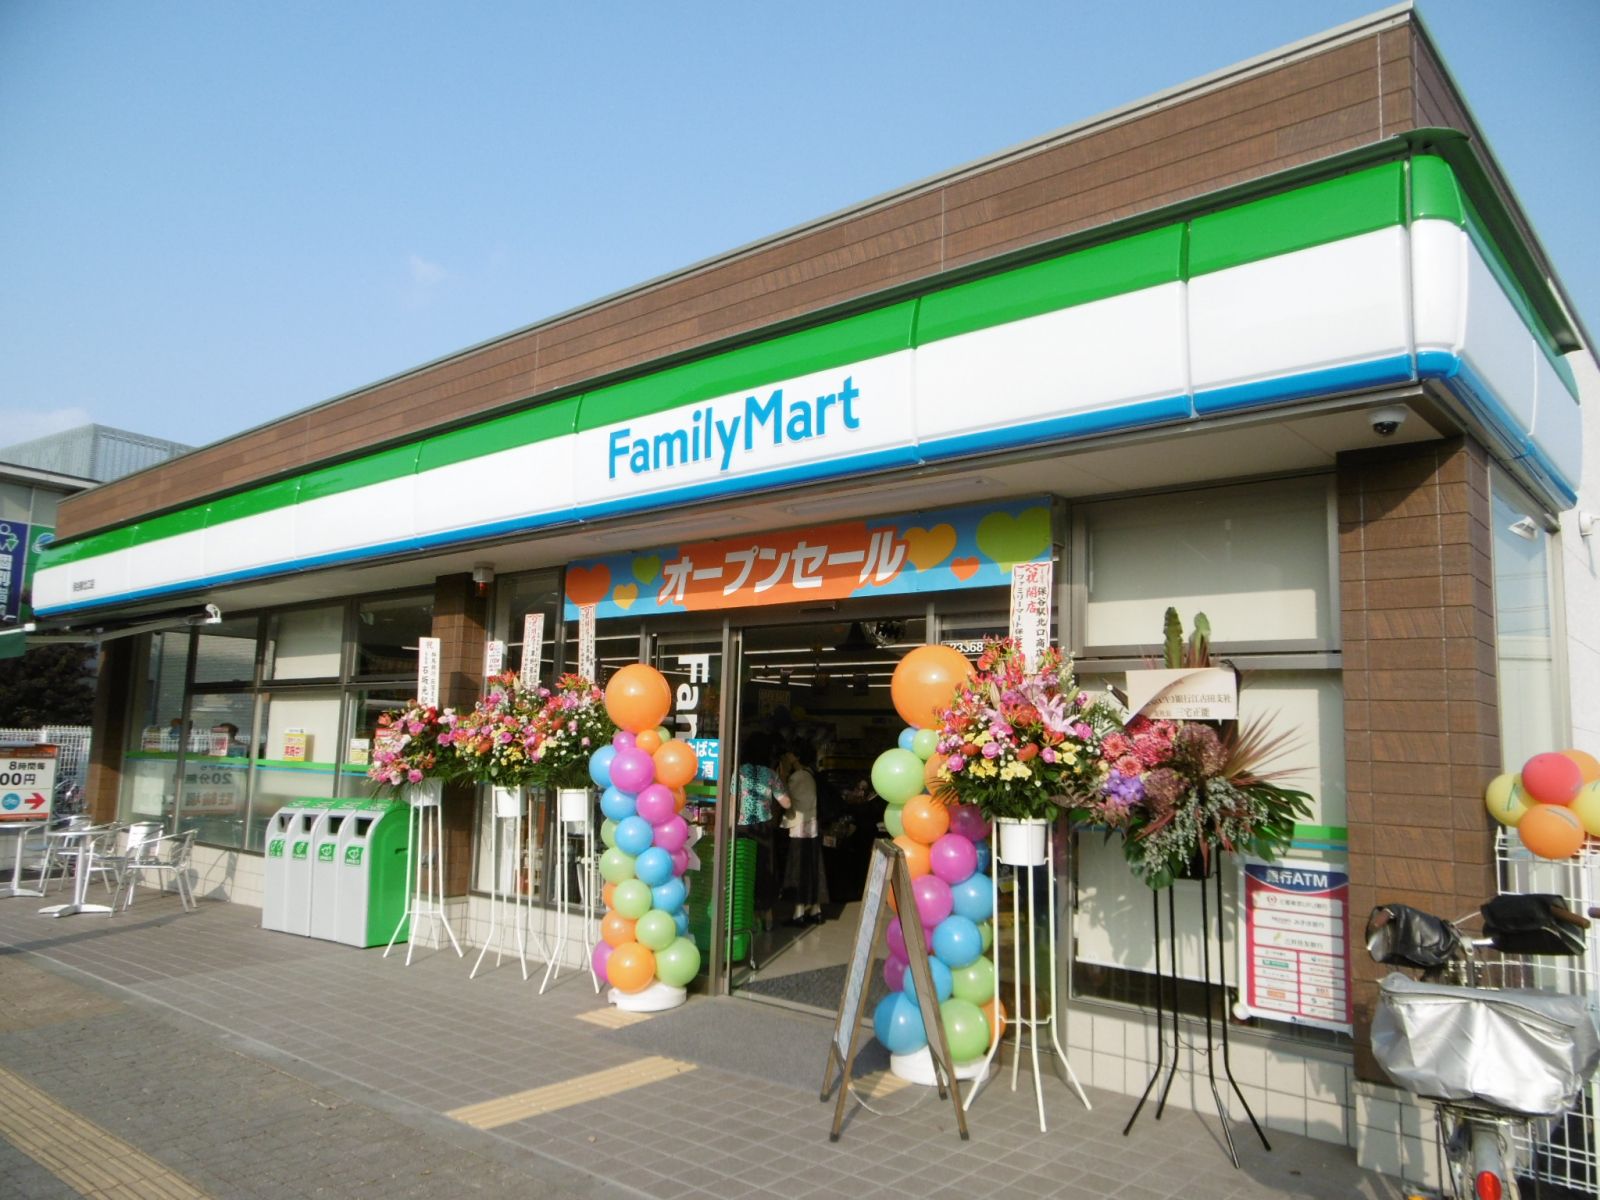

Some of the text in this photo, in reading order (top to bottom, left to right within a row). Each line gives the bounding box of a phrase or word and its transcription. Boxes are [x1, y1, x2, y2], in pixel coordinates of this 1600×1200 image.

[609, 376, 860, 480] FamilyMart
[658, 531, 906, 602] オープンセール
[1266, 870, 1329, 888] 銀行ATM
